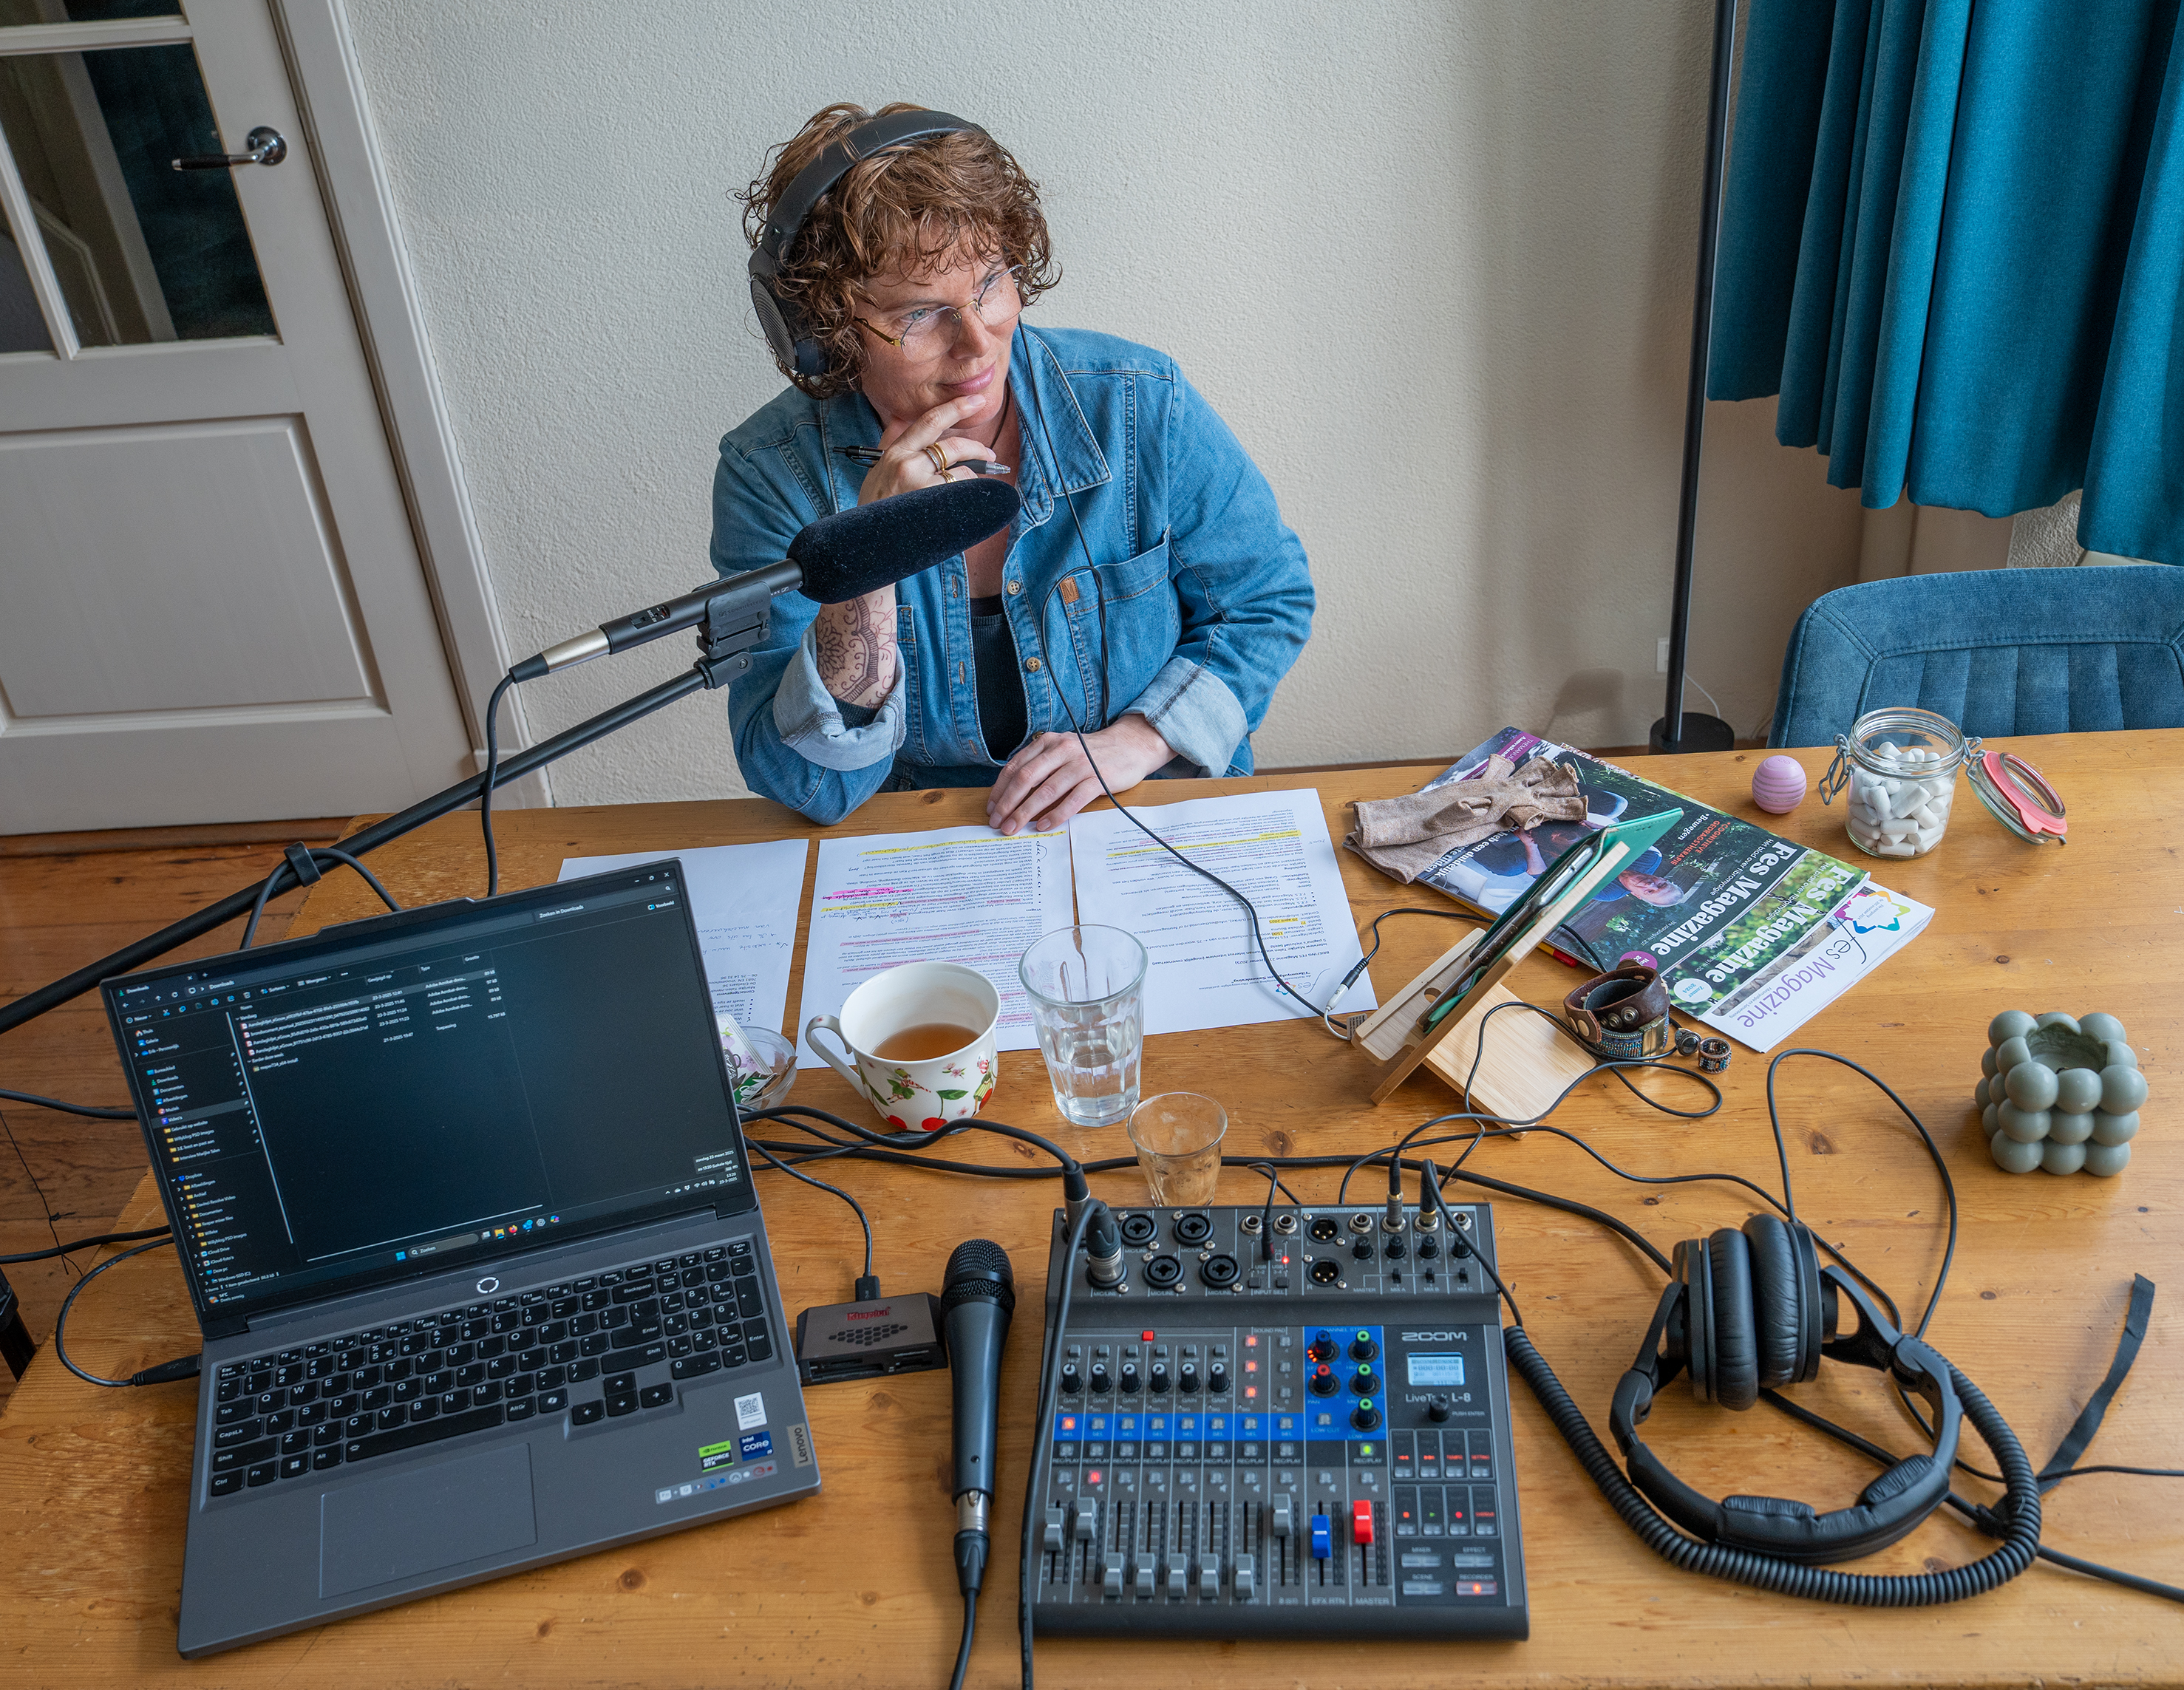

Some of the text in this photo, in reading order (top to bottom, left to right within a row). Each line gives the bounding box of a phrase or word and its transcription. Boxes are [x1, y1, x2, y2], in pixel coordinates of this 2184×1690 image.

[1676, 814, 1709, 840] Bewegen
[1486, 831, 1507, 843] heb
[1670, 820, 1721, 865] GEDRAGSTHERAPIE
[1694, 823, 1730, 853] COGNITIEVE
[1471, 840, 1491, 852] een
[1749, 846, 1765, 858] blad
[1432, 850, 1477, 878] duidelijk
[1738, 856, 1753, 868] over
[1709, 868, 1744, 896] fibromyalgie
[1806, 870, 1823, 883] blad
[1795, 882, 1809, 893] over
[1650, 841, 1797, 955] Fes Magazine
[1763, 893, 1800, 921] fibromyalgie
[1703, 865, 1854, 983] Fes Magazine
[1681, 982, 1697, 993] 2024
[1686, 985, 1705, 998] Zomer
[1736, 956, 1836, 1028] Magazine
[1401, 1331, 1468, 1342] ZOOM
[1452, 1391, 1472, 1403] L-8
[220, 1407, 233, 1415] Tab
[741, 1435, 755, 1444] intel
[794, 1426, 809, 1464] Lenovo
[702, 1451, 730, 1463] GEFORCE
[1355, 1597, 1389, 1605] MASTER
